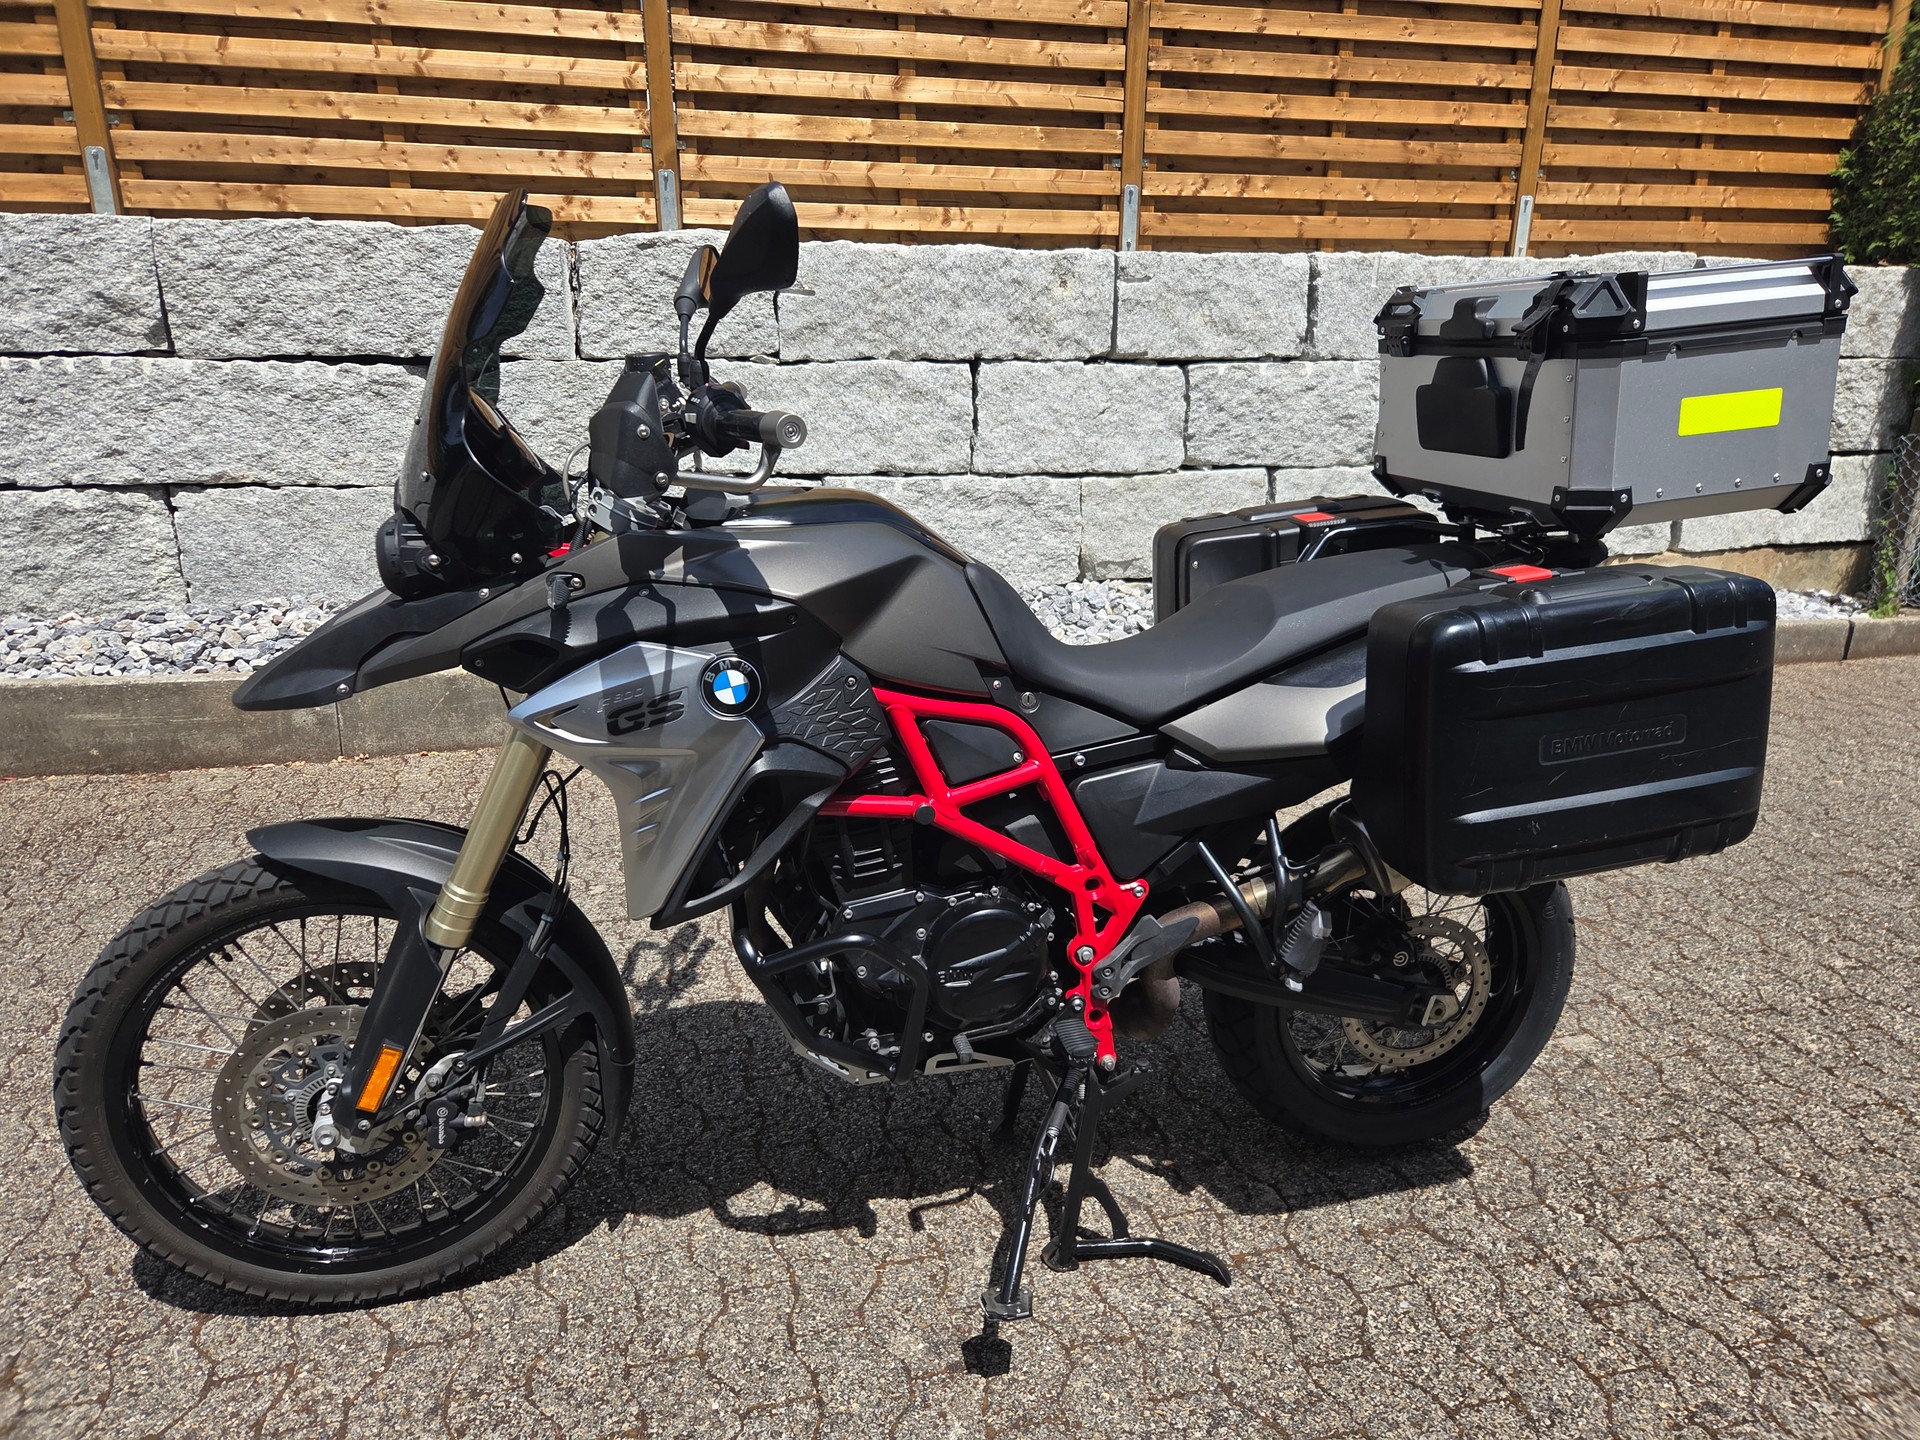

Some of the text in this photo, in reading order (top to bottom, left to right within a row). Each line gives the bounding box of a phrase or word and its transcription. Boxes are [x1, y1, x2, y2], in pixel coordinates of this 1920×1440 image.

[705, 660, 751, 683] BMW
[607, 691, 685, 736] GS
[1551, 721, 1675, 756] BMW Motorrad
